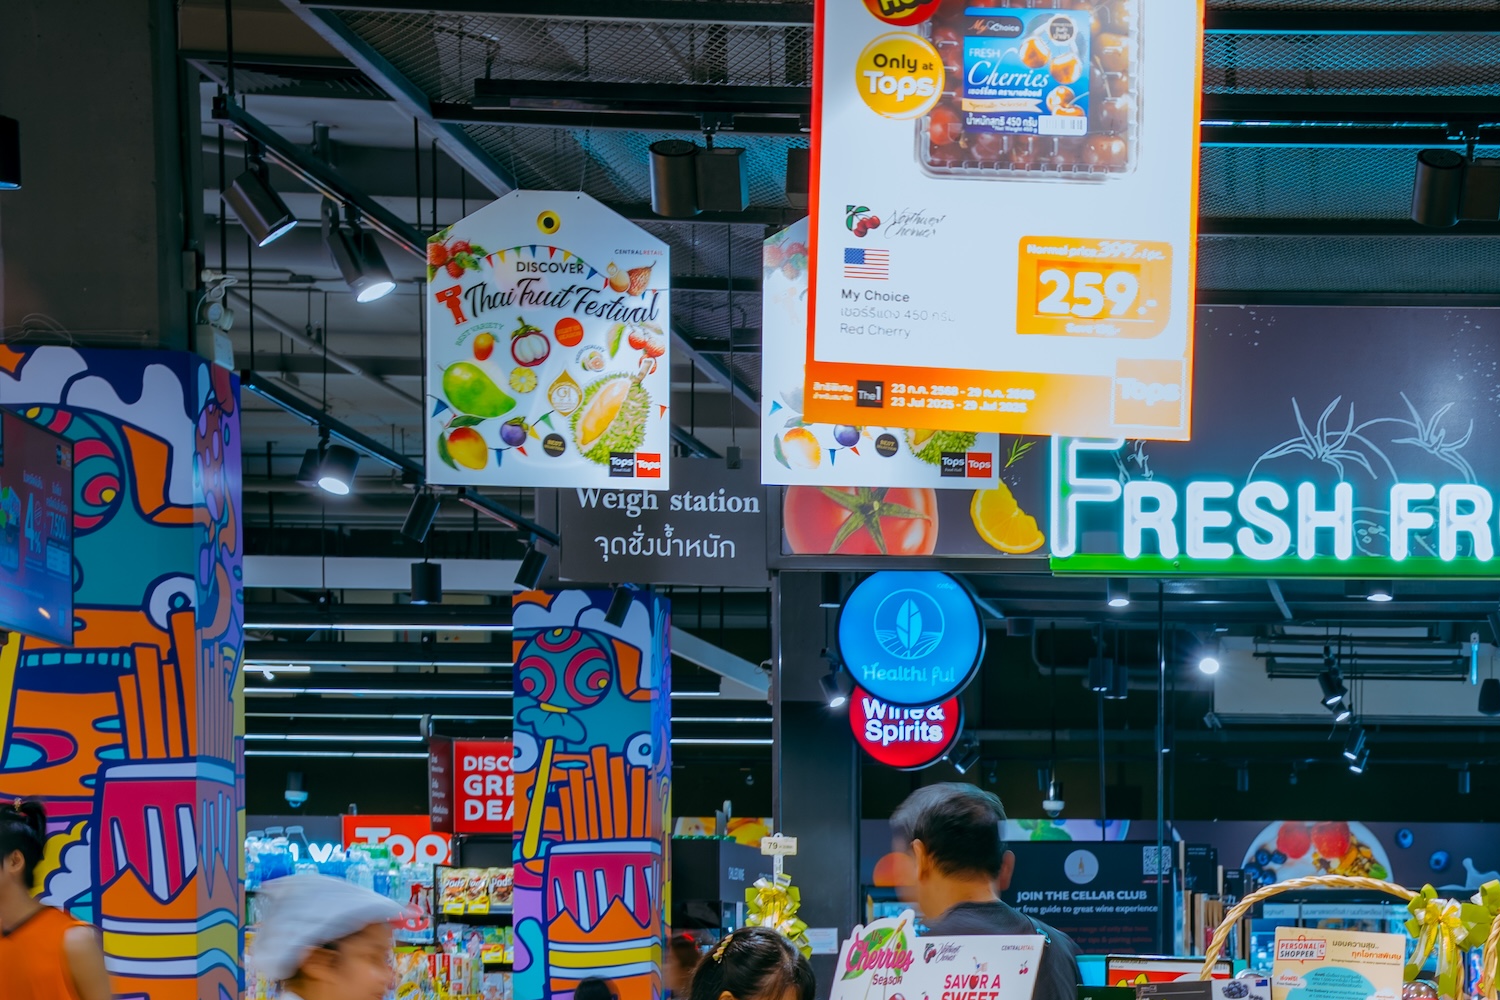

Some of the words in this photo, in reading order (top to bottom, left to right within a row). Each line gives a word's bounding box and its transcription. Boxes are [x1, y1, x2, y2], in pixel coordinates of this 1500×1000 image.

[968, 19, 987, 34] My
[969, 48, 1000, 58] FRESH
[873, 53, 918, 73] Only
[922, 62, 934, 70] at
[967, 60, 1050, 89] Cherries
[863, 70, 936, 102] Tops
[1006, 117, 1021, 126] 450
[516, 261, 584, 274] DISCOVER
[464, 281, 515, 317] Thai
[515, 277, 576, 307] Fruit
[571, 286, 660, 323] Festival
[841, 289, 860, 302] My
[864, 289, 910, 302] Choice
[904, 310, 928, 321] 450
[840, 323, 864, 335] Red
[868, 324, 911, 339] Cherry
[890, 383, 906, 394] 23
[1117, 377, 1182, 406] Tops
[890, 397, 905, 407] 23
[906, 397, 925, 408] Jul
[926, 399, 954, 410] 2025
[964, 400, 978, 410] 29
[979, 400, 998, 411] Jul
[610, 457, 634, 467] Tops
[637, 460, 660, 471] Tops
[941, 457, 965, 469] Tops
[968, 459, 992, 471] Tops
[575, 488, 659, 518] Weigh
[670, 488, 761, 513] station
[1050, 435, 1354, 560] FRESH
[594, 523, 736, 562] จุดชั่งน้ำหนัก
[865, 719, 943, 745] Spirits
[355, 827, 452, 864] Top
[1016, 891, 1044, 903] JOIN
[1045, 891, 1070, 900] THE
[1071, 891, 1115, 901] CELLAR
[1115, 891, 1147, 900] CLUB
[1022, 904, 1039, 914] free
[1040, 904, 1060, 915] guide
[1062, 905, 1071, 913] to
[1073, 905, 1093, 915] great
[1094, 905, 1114, 913] wine
[1115, 905, 1158, 915] experience
[846, 931, 915, 972] Cherries
[1280, 942, 1317, 951] PERSONAL
[1280, 950, 1315, 958] SHOPPER
[872, 974, 902, 985] Season
[944, 974, 987, 989] SAVOR
[991, 975, 1001, 988] A
